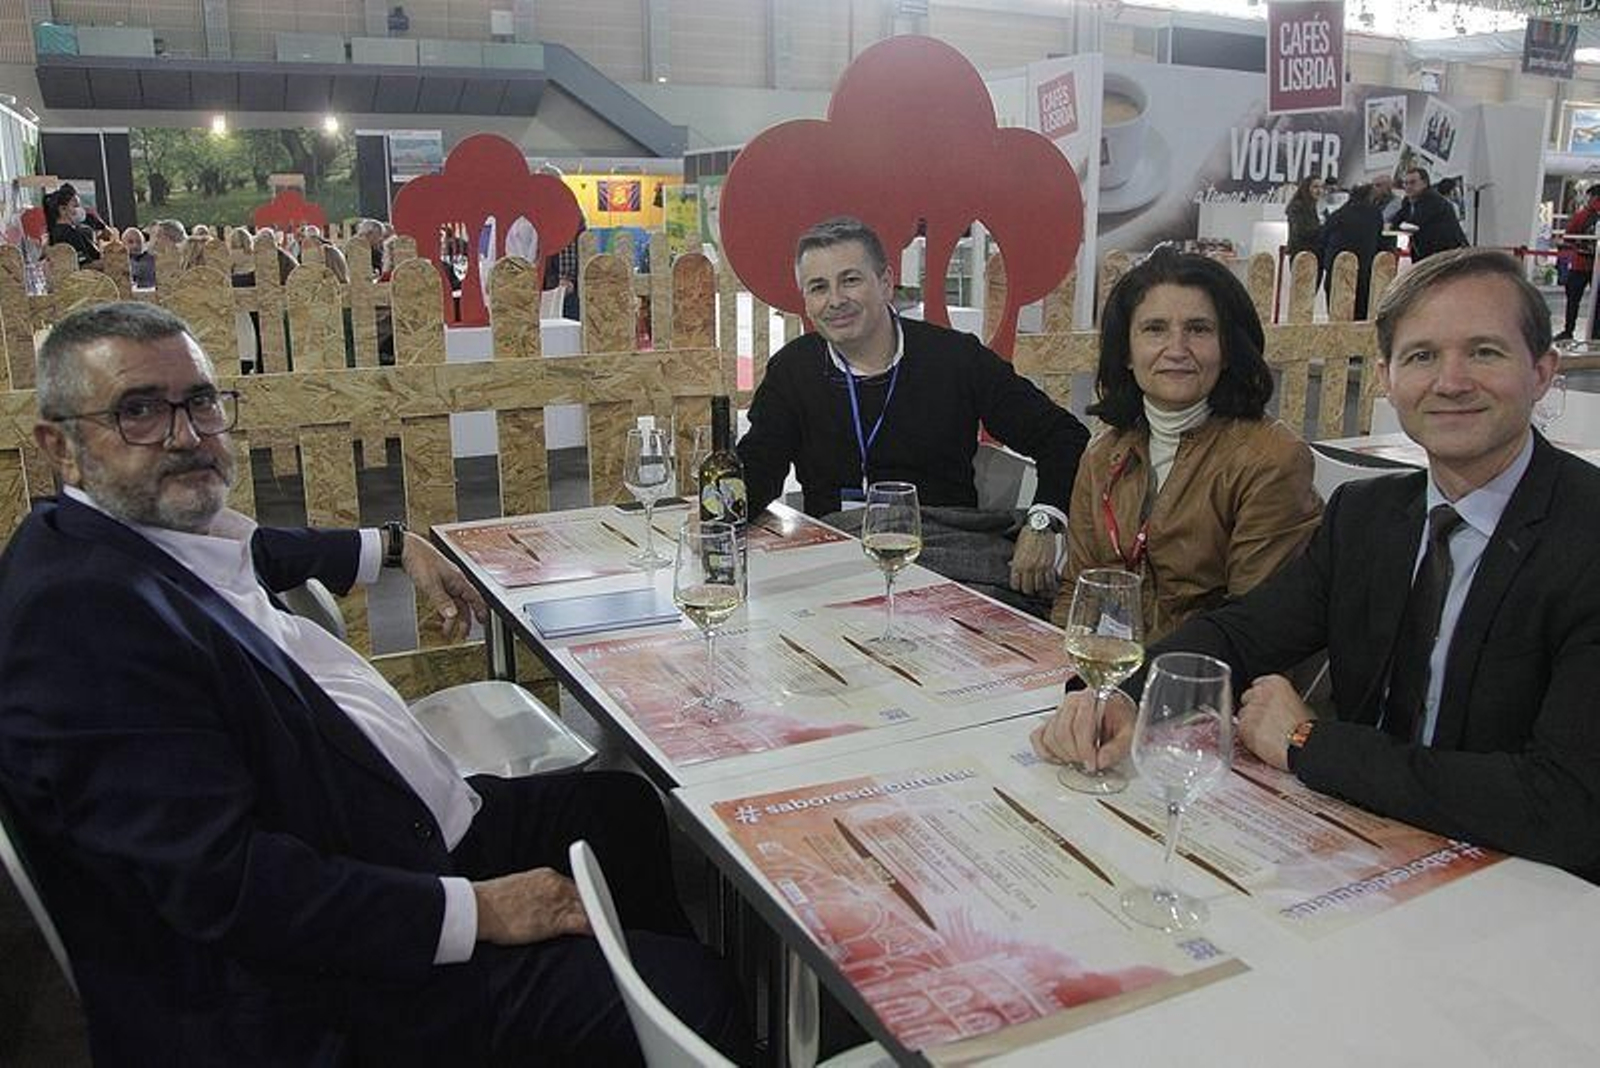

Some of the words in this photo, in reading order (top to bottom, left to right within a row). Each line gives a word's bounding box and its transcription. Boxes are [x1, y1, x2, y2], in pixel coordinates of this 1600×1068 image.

[1280, 12, 1330, 55] CAFÉS
[1279, 56, 1337, 92] LISBOA
[1042, 103, 1076, 133] LISBOA
[1230, 127, 1341, 183] VOLVER
